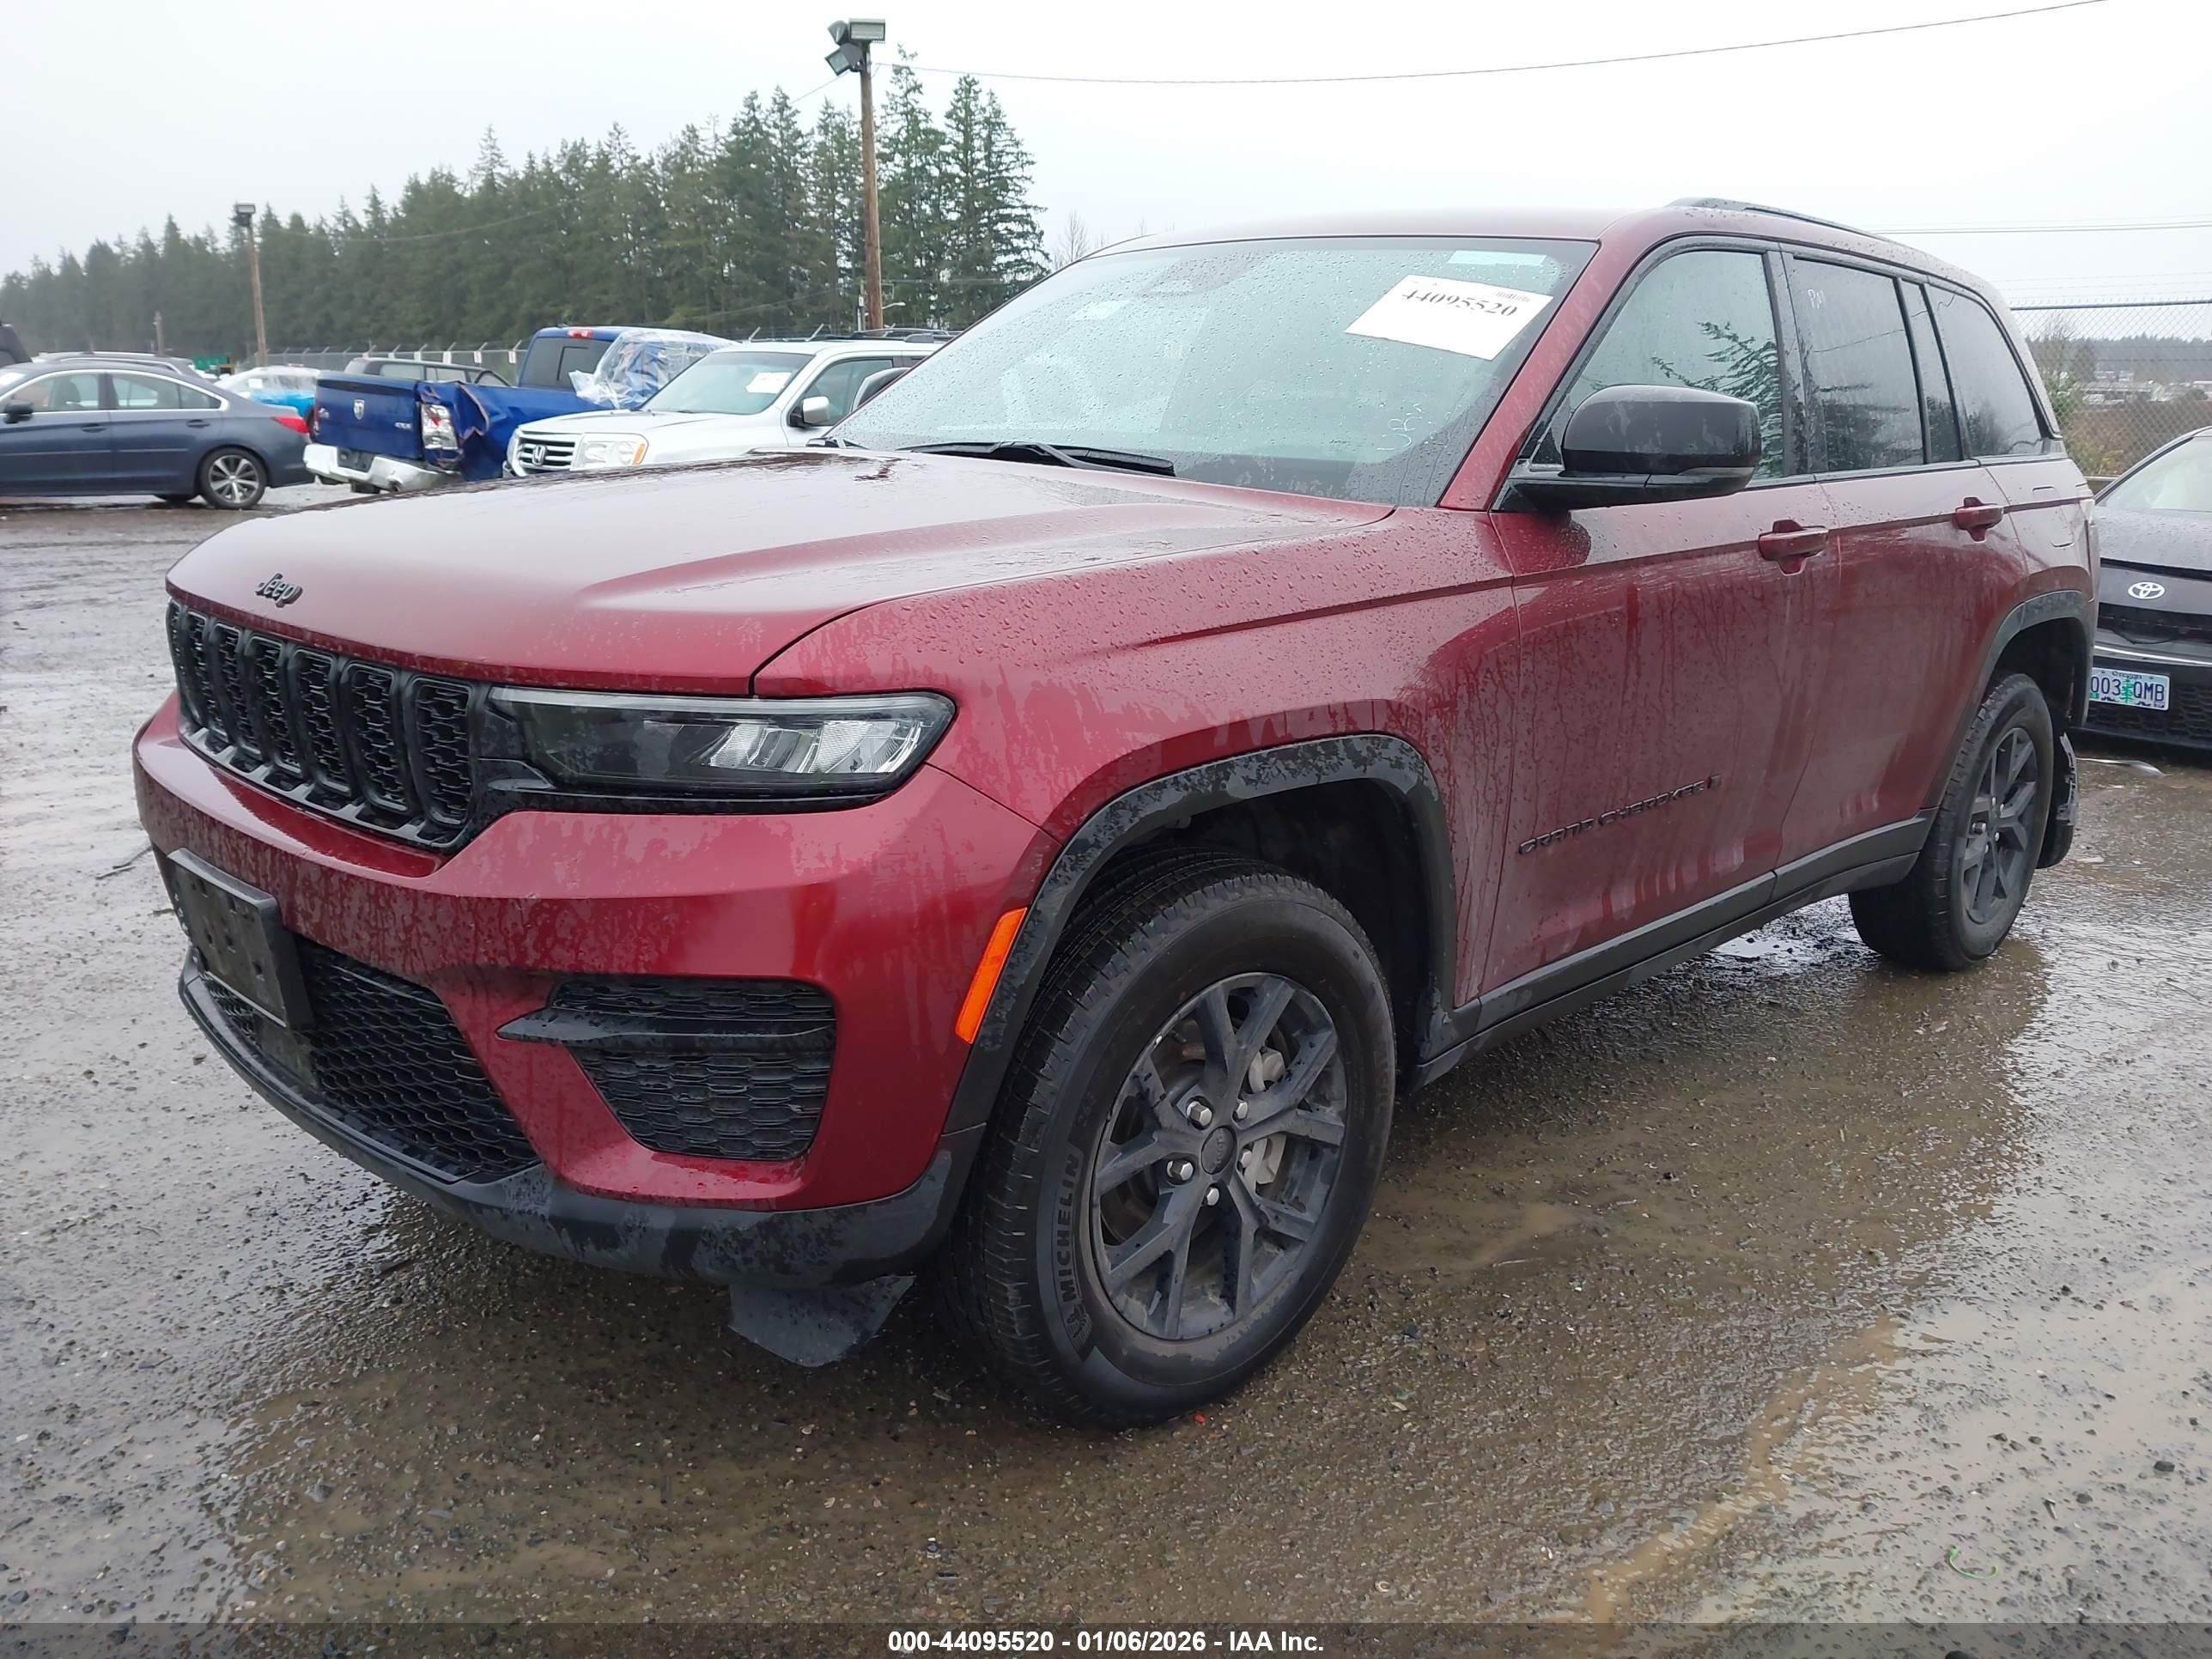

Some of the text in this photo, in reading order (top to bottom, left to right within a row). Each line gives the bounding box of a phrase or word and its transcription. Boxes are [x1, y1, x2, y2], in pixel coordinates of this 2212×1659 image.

[1401, 289, 1518, 316] 44095520
[255, 573, 303, 608] Jeep
[2112, 671, 2142, 680] Oregon
[2133, 682, 2165, 702] QMB
[1598, 780, 1705, 826] CHEROKEE
[1055, 1153, 1080, 1304] MICHELIN
